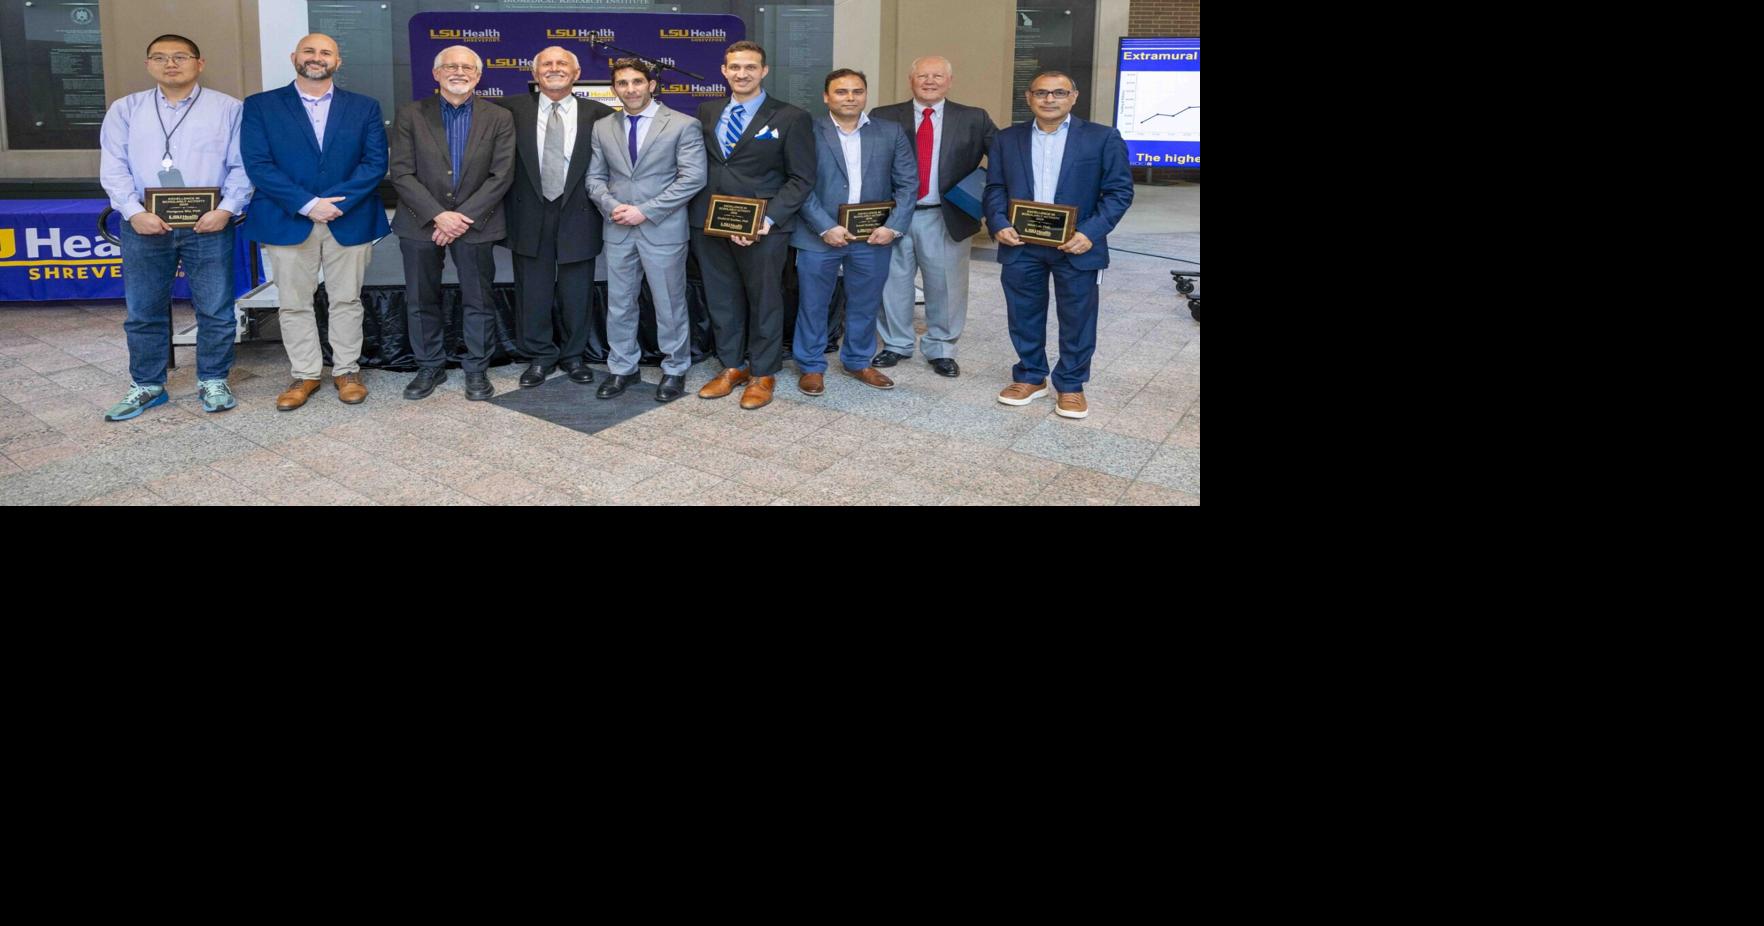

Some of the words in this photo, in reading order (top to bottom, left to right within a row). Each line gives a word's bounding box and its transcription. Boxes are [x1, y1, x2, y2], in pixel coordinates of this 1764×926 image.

[430, 29, 460, 37] LSU
[463, 29, 500, 37] Health
[546, 29, 576, 37] LSU
[578, 29, 615, 37] Hlth
[659, 29, 689, 37] LSU
[690, 29, 726, 37] Health
[1123, 52, 1198, 60] Extramural
[486, 58, 516, 66] LSU
[473, 88, 504, 96] ealth
[661, 84, 689, 92] LSU
[691, 84, 726, 92] Health
[1136, 153, 1161, 162] The
[26, 228, 121, 257] Hea
[29, 266, 122, 280] SHREVE
